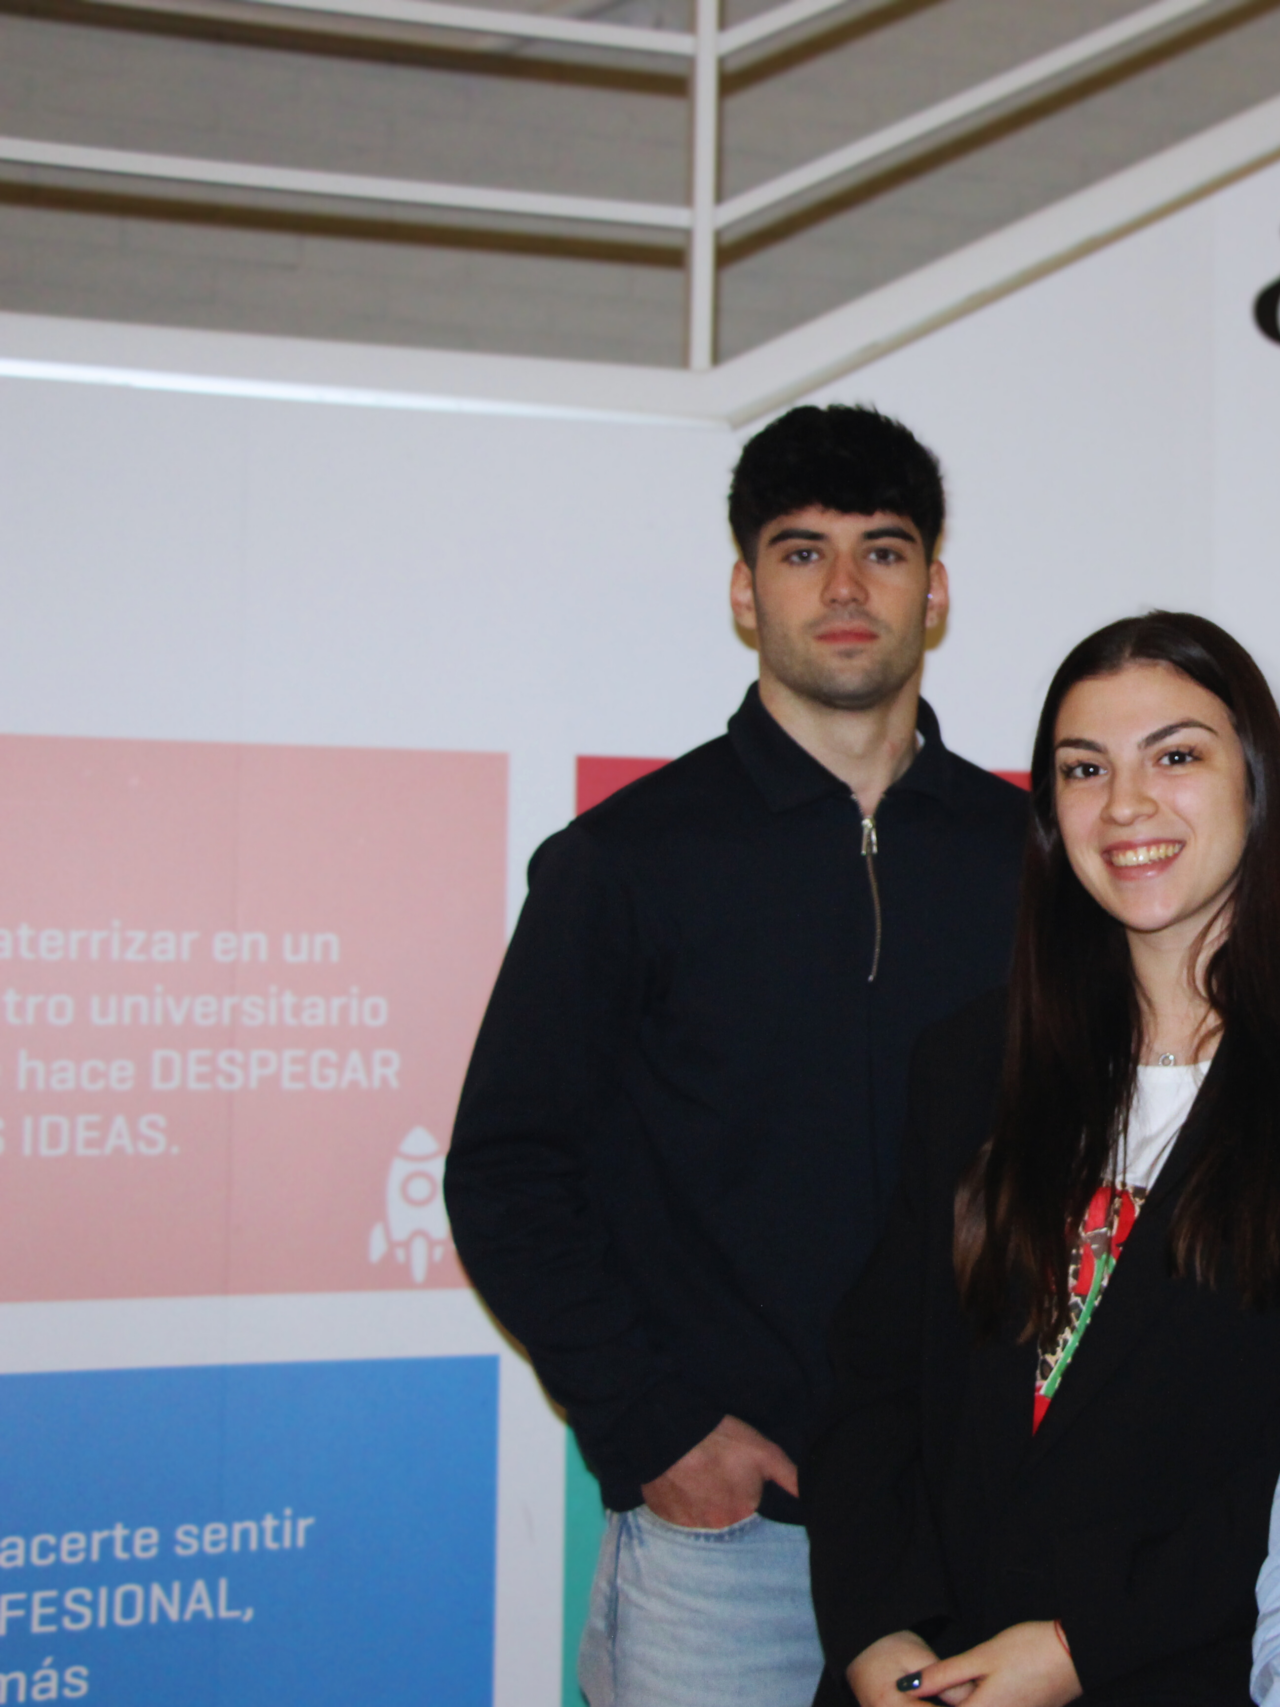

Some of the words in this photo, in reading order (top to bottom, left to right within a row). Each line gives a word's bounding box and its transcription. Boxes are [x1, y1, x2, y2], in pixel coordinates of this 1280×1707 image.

[212, 930, 268, 963] en
[282, 930, 340, 963] un
[90, 984, 389, 1027] universitario
[17, 1048, 136, 1091] hace
[151, 1048, 402, 1091] DESPEGAR
[23, 1114, 180, 1157] IDEAS.
[174, 1507, 316, 1557] sentir
